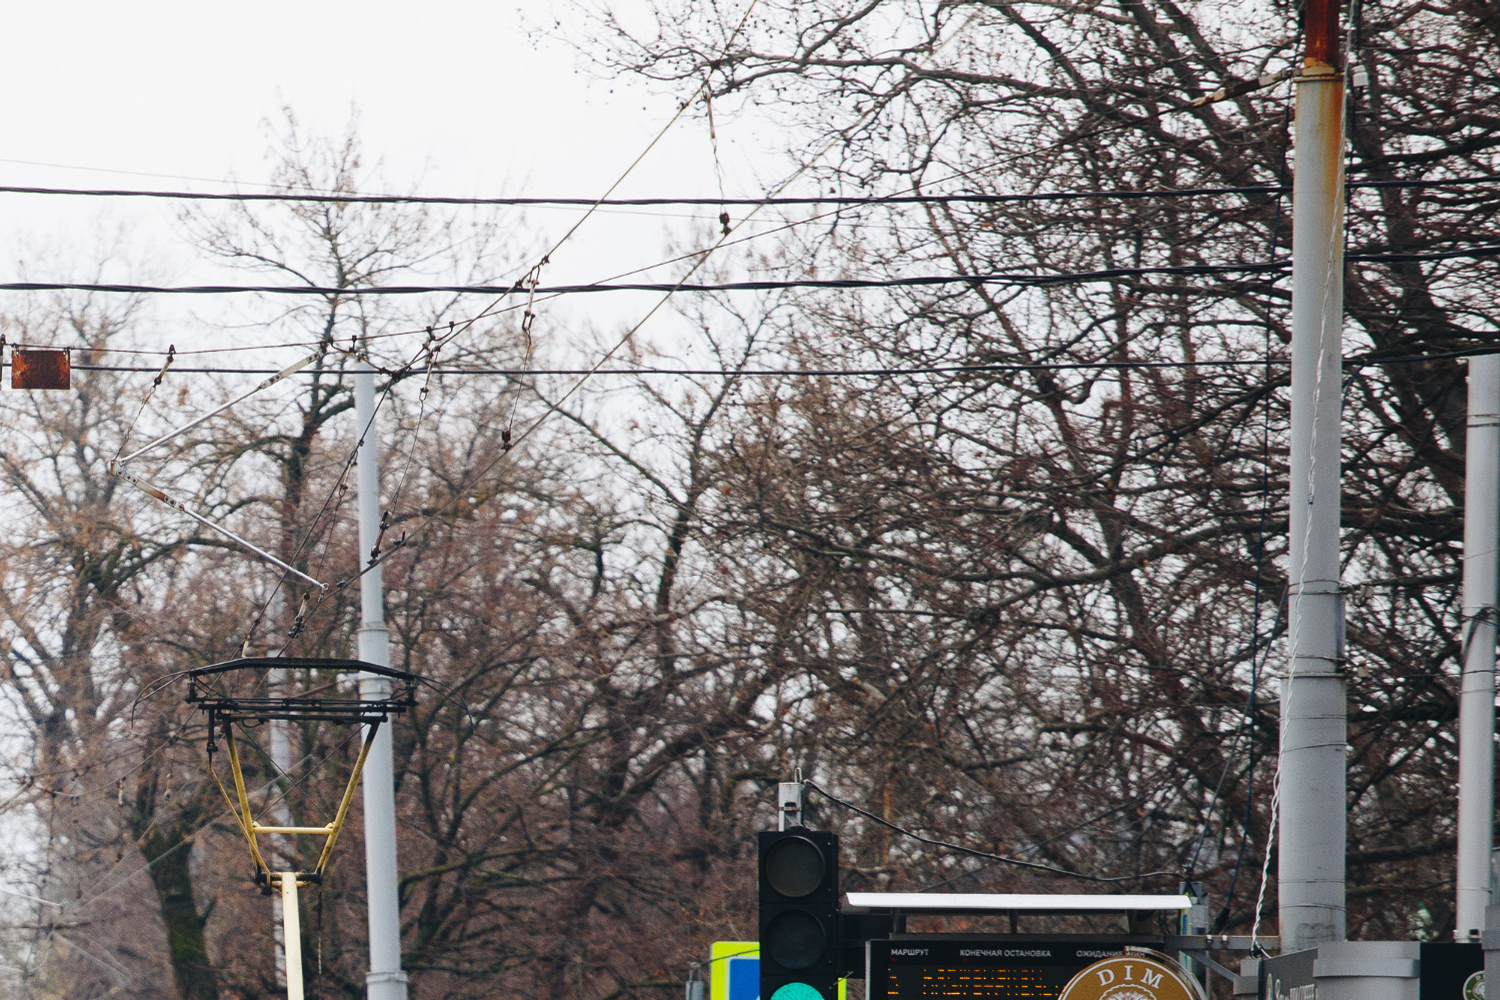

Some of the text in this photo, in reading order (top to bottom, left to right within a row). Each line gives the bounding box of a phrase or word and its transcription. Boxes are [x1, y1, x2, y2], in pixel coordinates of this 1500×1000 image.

[960, 949, 1051, 957] КОНЕЧНАЯ ОСТАНОВКА
[1096, 965, 1164, 989] DIM
